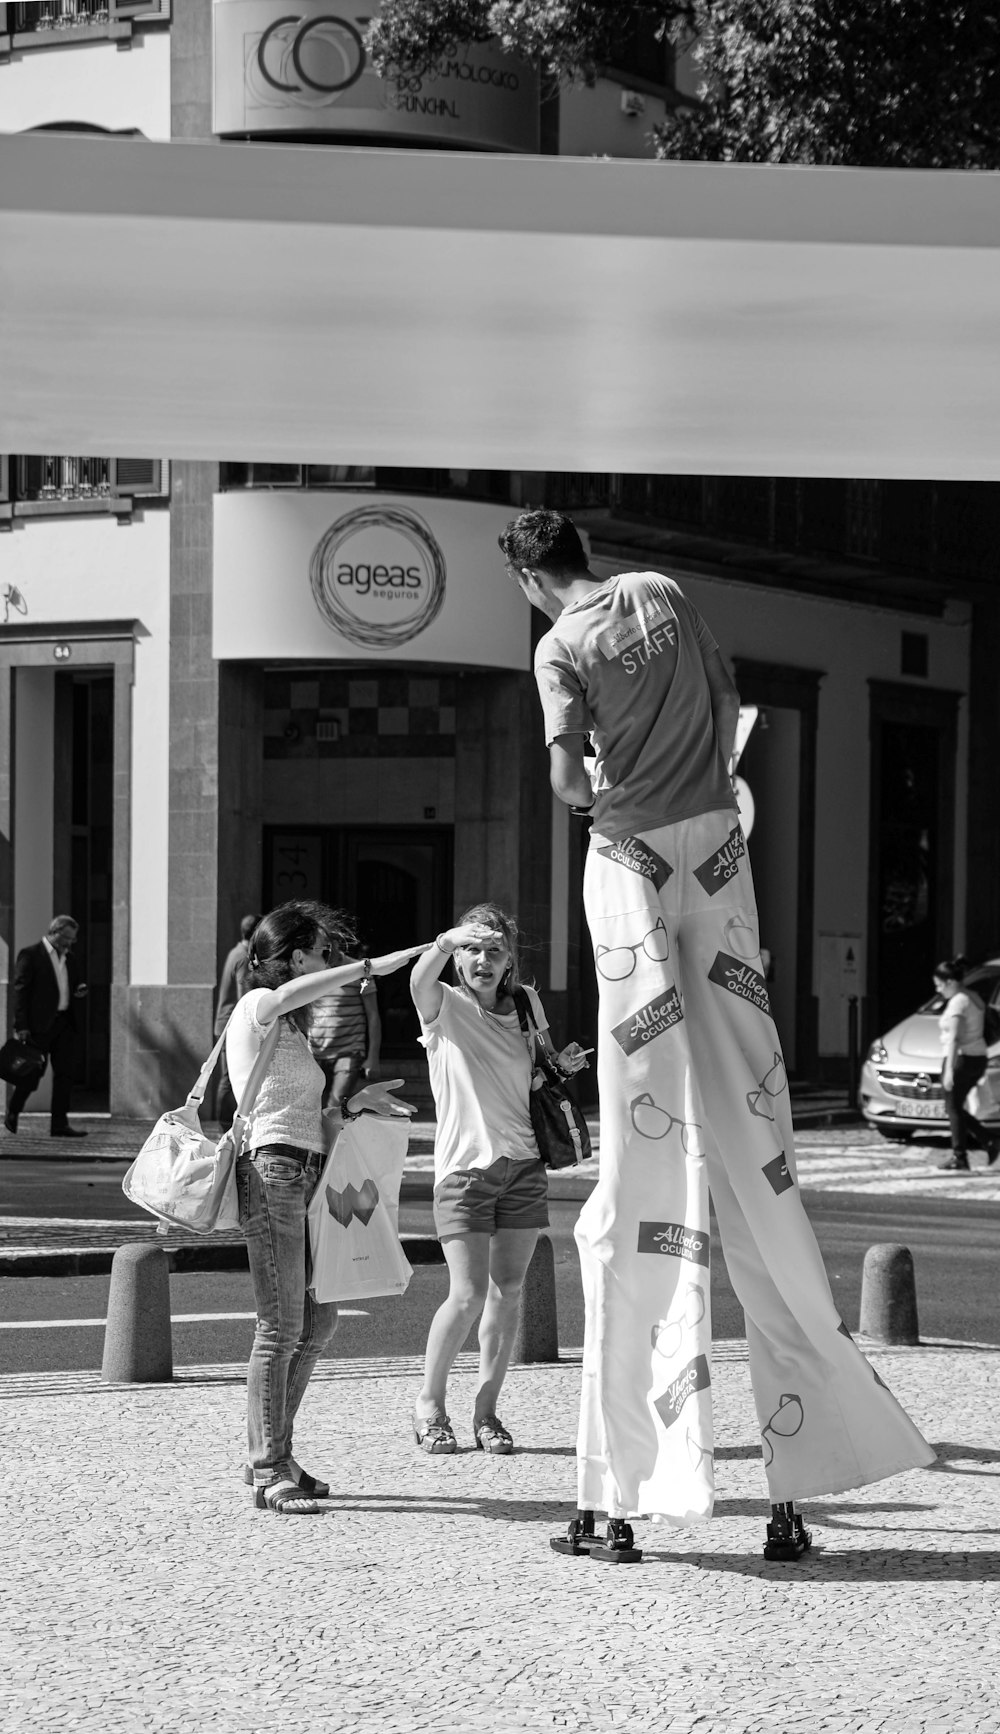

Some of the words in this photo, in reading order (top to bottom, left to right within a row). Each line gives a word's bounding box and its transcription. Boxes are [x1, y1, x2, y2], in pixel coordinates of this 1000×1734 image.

[337, 563, 422, 595] ageas
[373, 589, 420, 600] seguros
[621, 624, 675, 675] STAFF
[610, 850, 653, 878] OCULISTA
[727, 980, 770, 1013] OCULISTA
[630, 992, 680, 1038] Albert
[641, 1008, 683, 1041] OCULIST
